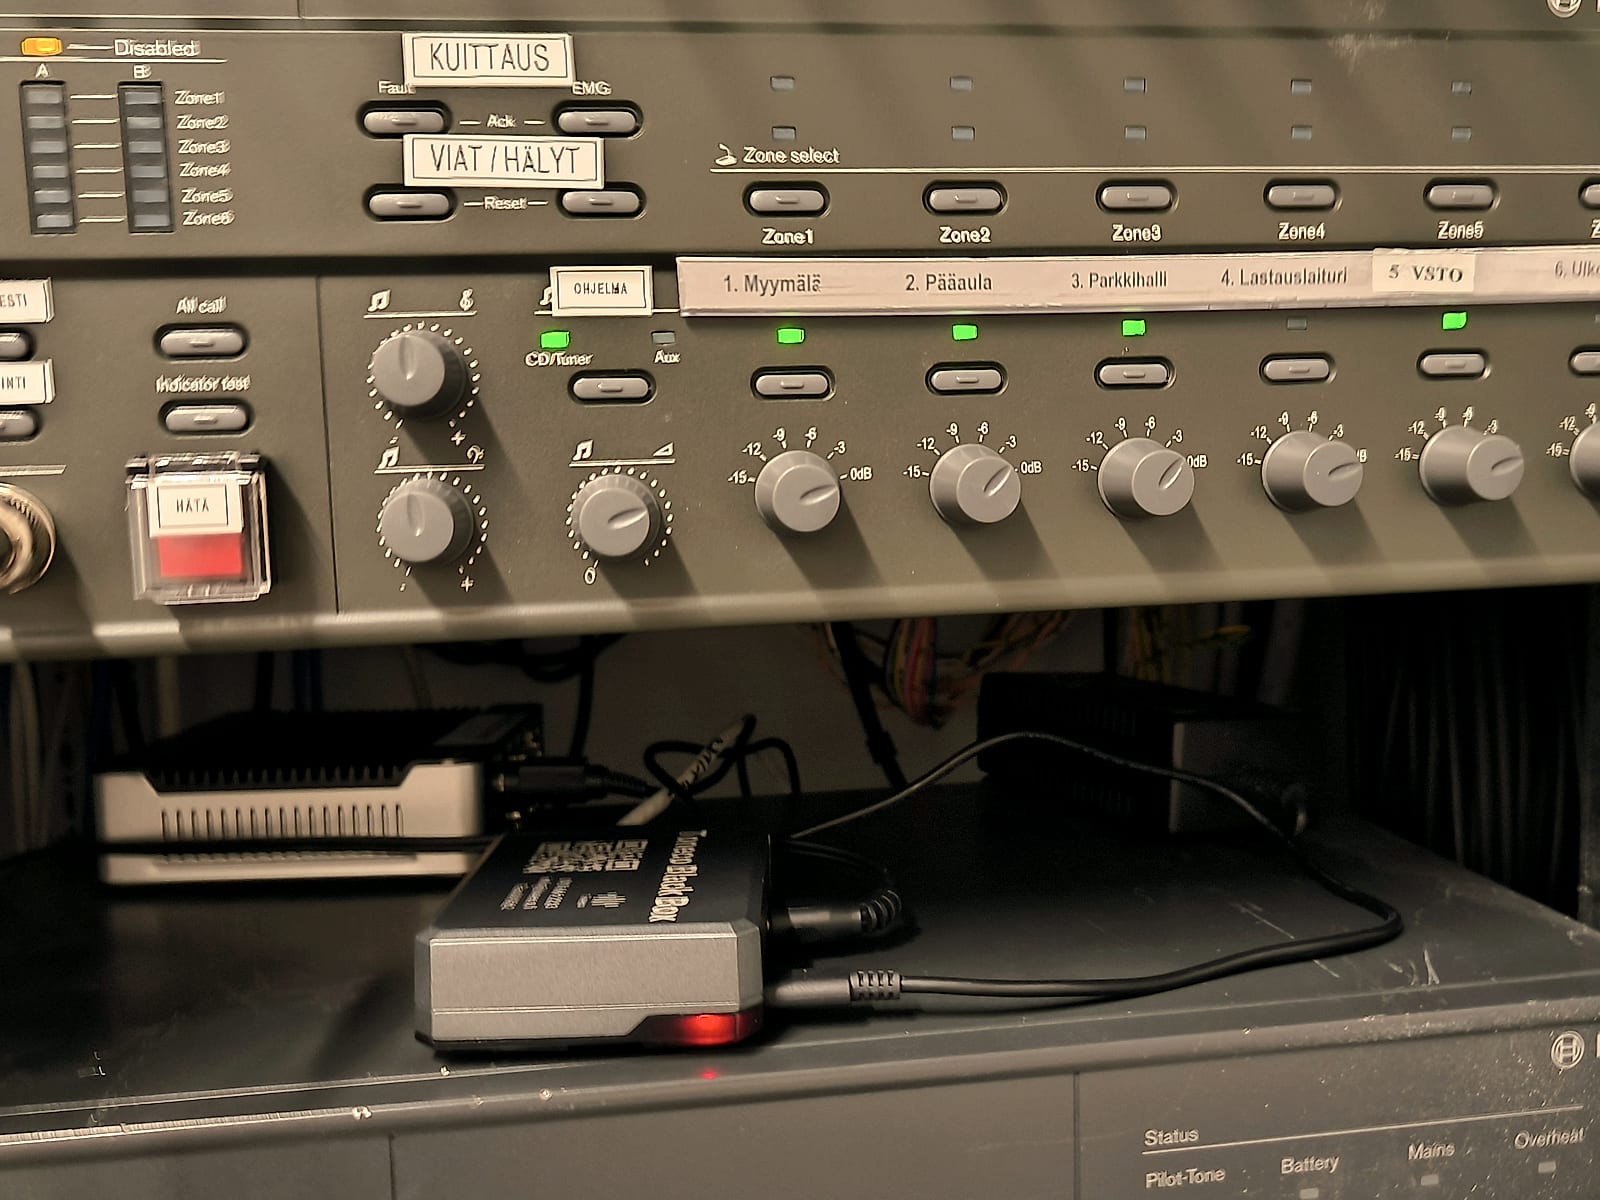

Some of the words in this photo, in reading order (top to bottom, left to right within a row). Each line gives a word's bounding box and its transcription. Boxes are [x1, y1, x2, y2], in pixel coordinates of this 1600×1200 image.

[113, 38, 200, 57] Disabled
[430, 42, 551, 72] KUITTAUS
[35, 63, 49, 79] A
[133, 64, 151, 79] B
[572, 80, 612, 95] EMG
[174, 90, 225, 106] Zone1
[176, 114, 229, 130] Zone2
[487, 113, 517, 128] Ack
[177, 138, 231, 154] Zone3
[743, 146, 787, 164] Zone
[790, 146, 840, 164] select
[179, 162, 232, 178] Zone4
[181, 187, 234, 204] Zone5
[484, 196, 527, 211] Reset
[182, 209, 235, 226] Zone6
[762, 227, 814, 245] Zone1
[939, 225, 992, 244] Zone2
[1112, 223, 1162, 242] Zone3
[1278, 221, 1326, 241] Zone4
[1437, 220, 1484, 240] Zone5
[905, 273, 920, 292] 2.
[925, 271, 992, 292] Pääaula
[1071, 272, 1084, 290] 3.
[1221, 267, 1234, 287] 4.
[1240, 265, 1347, 286] Lastauslaituri
[1412, 264, 1463, 283] VSTO
[574, 281, 628, 295] OHJELMA
[724, 274, 738, 293] 1.
[744, 273, 822, 297] Myymälä
[176, 296, 197, 314] All
[198, 295, 227, 314] call
[524, 351, 594, 367] CD/Tuner
[653, 349, 681, 364] Aux
[156, 374, 220, 393] Indicator
[221, 374, 250, 393] test
[946, 423, 959, 436] -9
[977, 421, 990, 435] -6
[1114, 417, 1126, 431] -9
[1144, 415, 1156, 430] -6
[772, 427, 787, 442] -9
[804, 426, 818, 441] -6
[1004, 435, 1017, 448] -3
[1086, 431, 1103, 445] -12
[1172, 429, 1183, 443] -3
[742, 441, 762, 456] -12
[833, 440, 847, 454] -3
[917, 437, 935, 451] -12
[1020, 461, 1043, 475] 0dB
[1071, 459, 1090, 472] -15
[1186, 454, 1208, 469] 0dB
[728, 470, 747, 485] -15
[850, 467, 873, 481] 0dB
[902, 465, 921, 479] -15
[658, 864, 699, 897] Black
[649, 896, 689, 923] Box
[1143, 1128, 1199, 1147] Status
[1514, 1127, 1585, 1149] Overheat
[1408, 1141, 1455, 1160] Mains
[1281, 1154, 1339, 1175] Battery
[1145, 1167, 1226, 1190] Pilot-Tone
